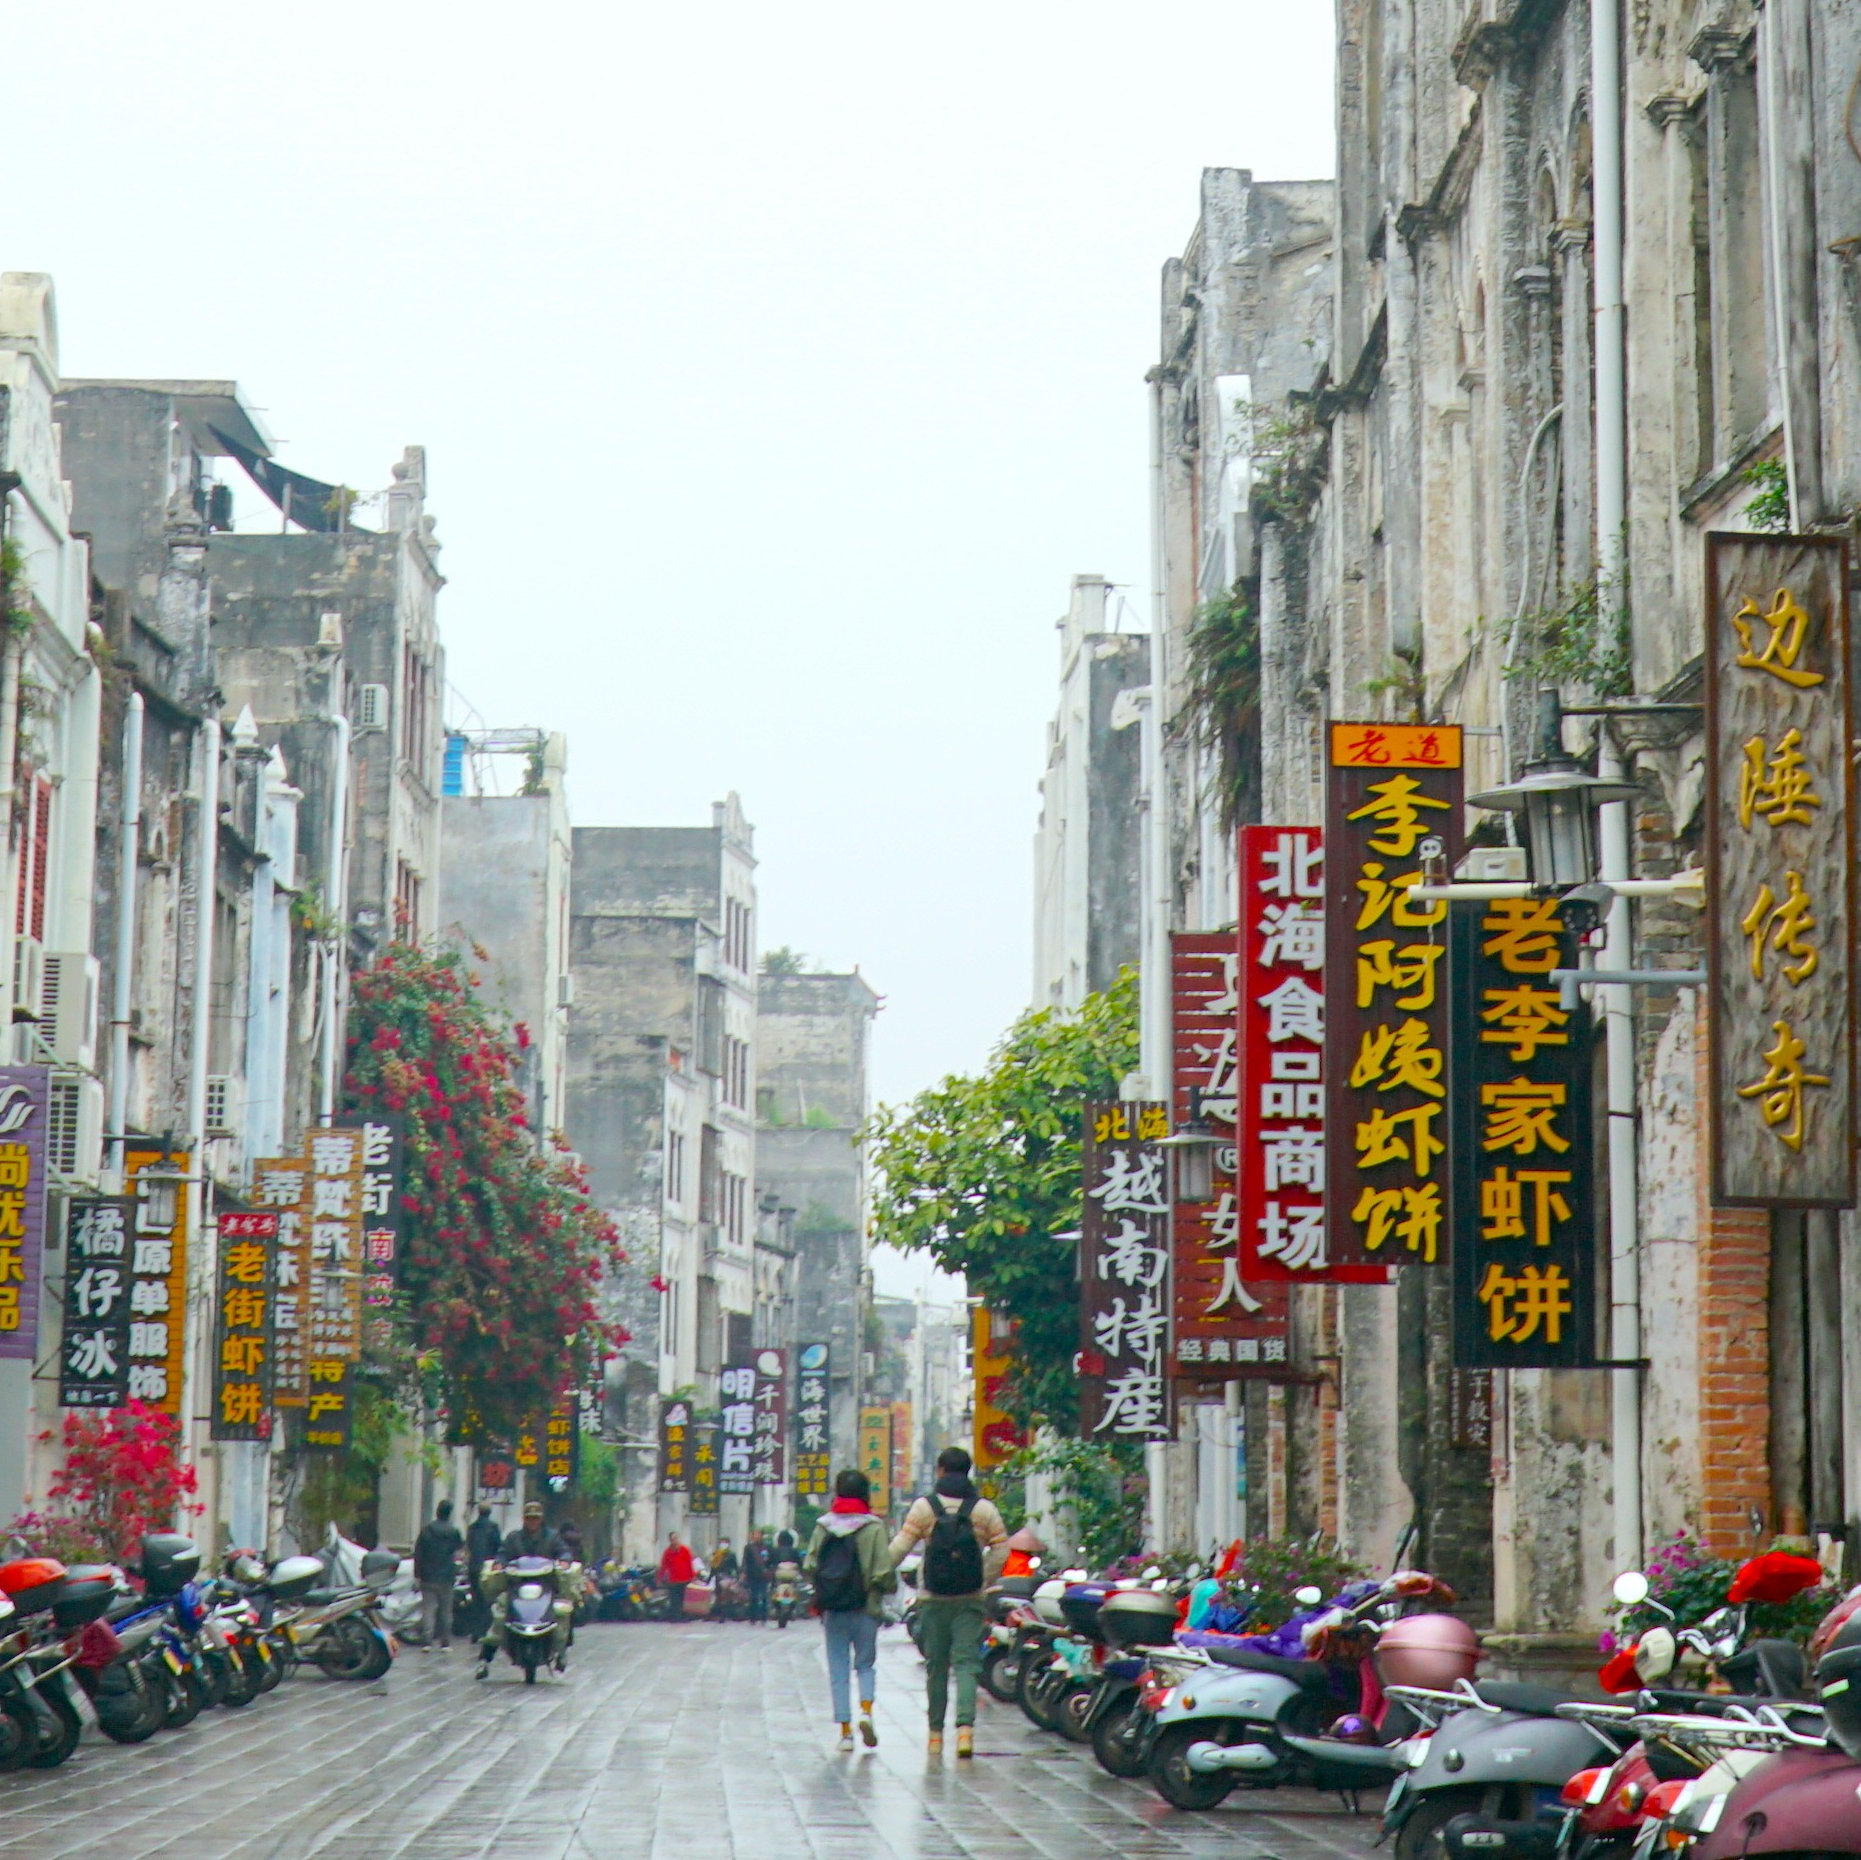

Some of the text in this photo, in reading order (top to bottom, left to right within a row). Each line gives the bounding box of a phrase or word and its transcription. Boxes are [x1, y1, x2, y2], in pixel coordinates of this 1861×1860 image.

[1349, 731, 1446, 766] 老道
[1734, 587, 1831, 1154] 边陲传奇
[1258, 833, 1325, 1270] 北海食品商场
[1348, 774, 1451, 1265] 李记阿姨虾饼
[1094, 1108, 1168, 1142] 北海
[1480, 895, 1572, 1343] 老李家虾饼
[220, 1242, 268, 1424] 老街虾饼
[721, 1368, 756, 1471] 明信片
[1177, 1339, 1287, 1362] 经典国货
